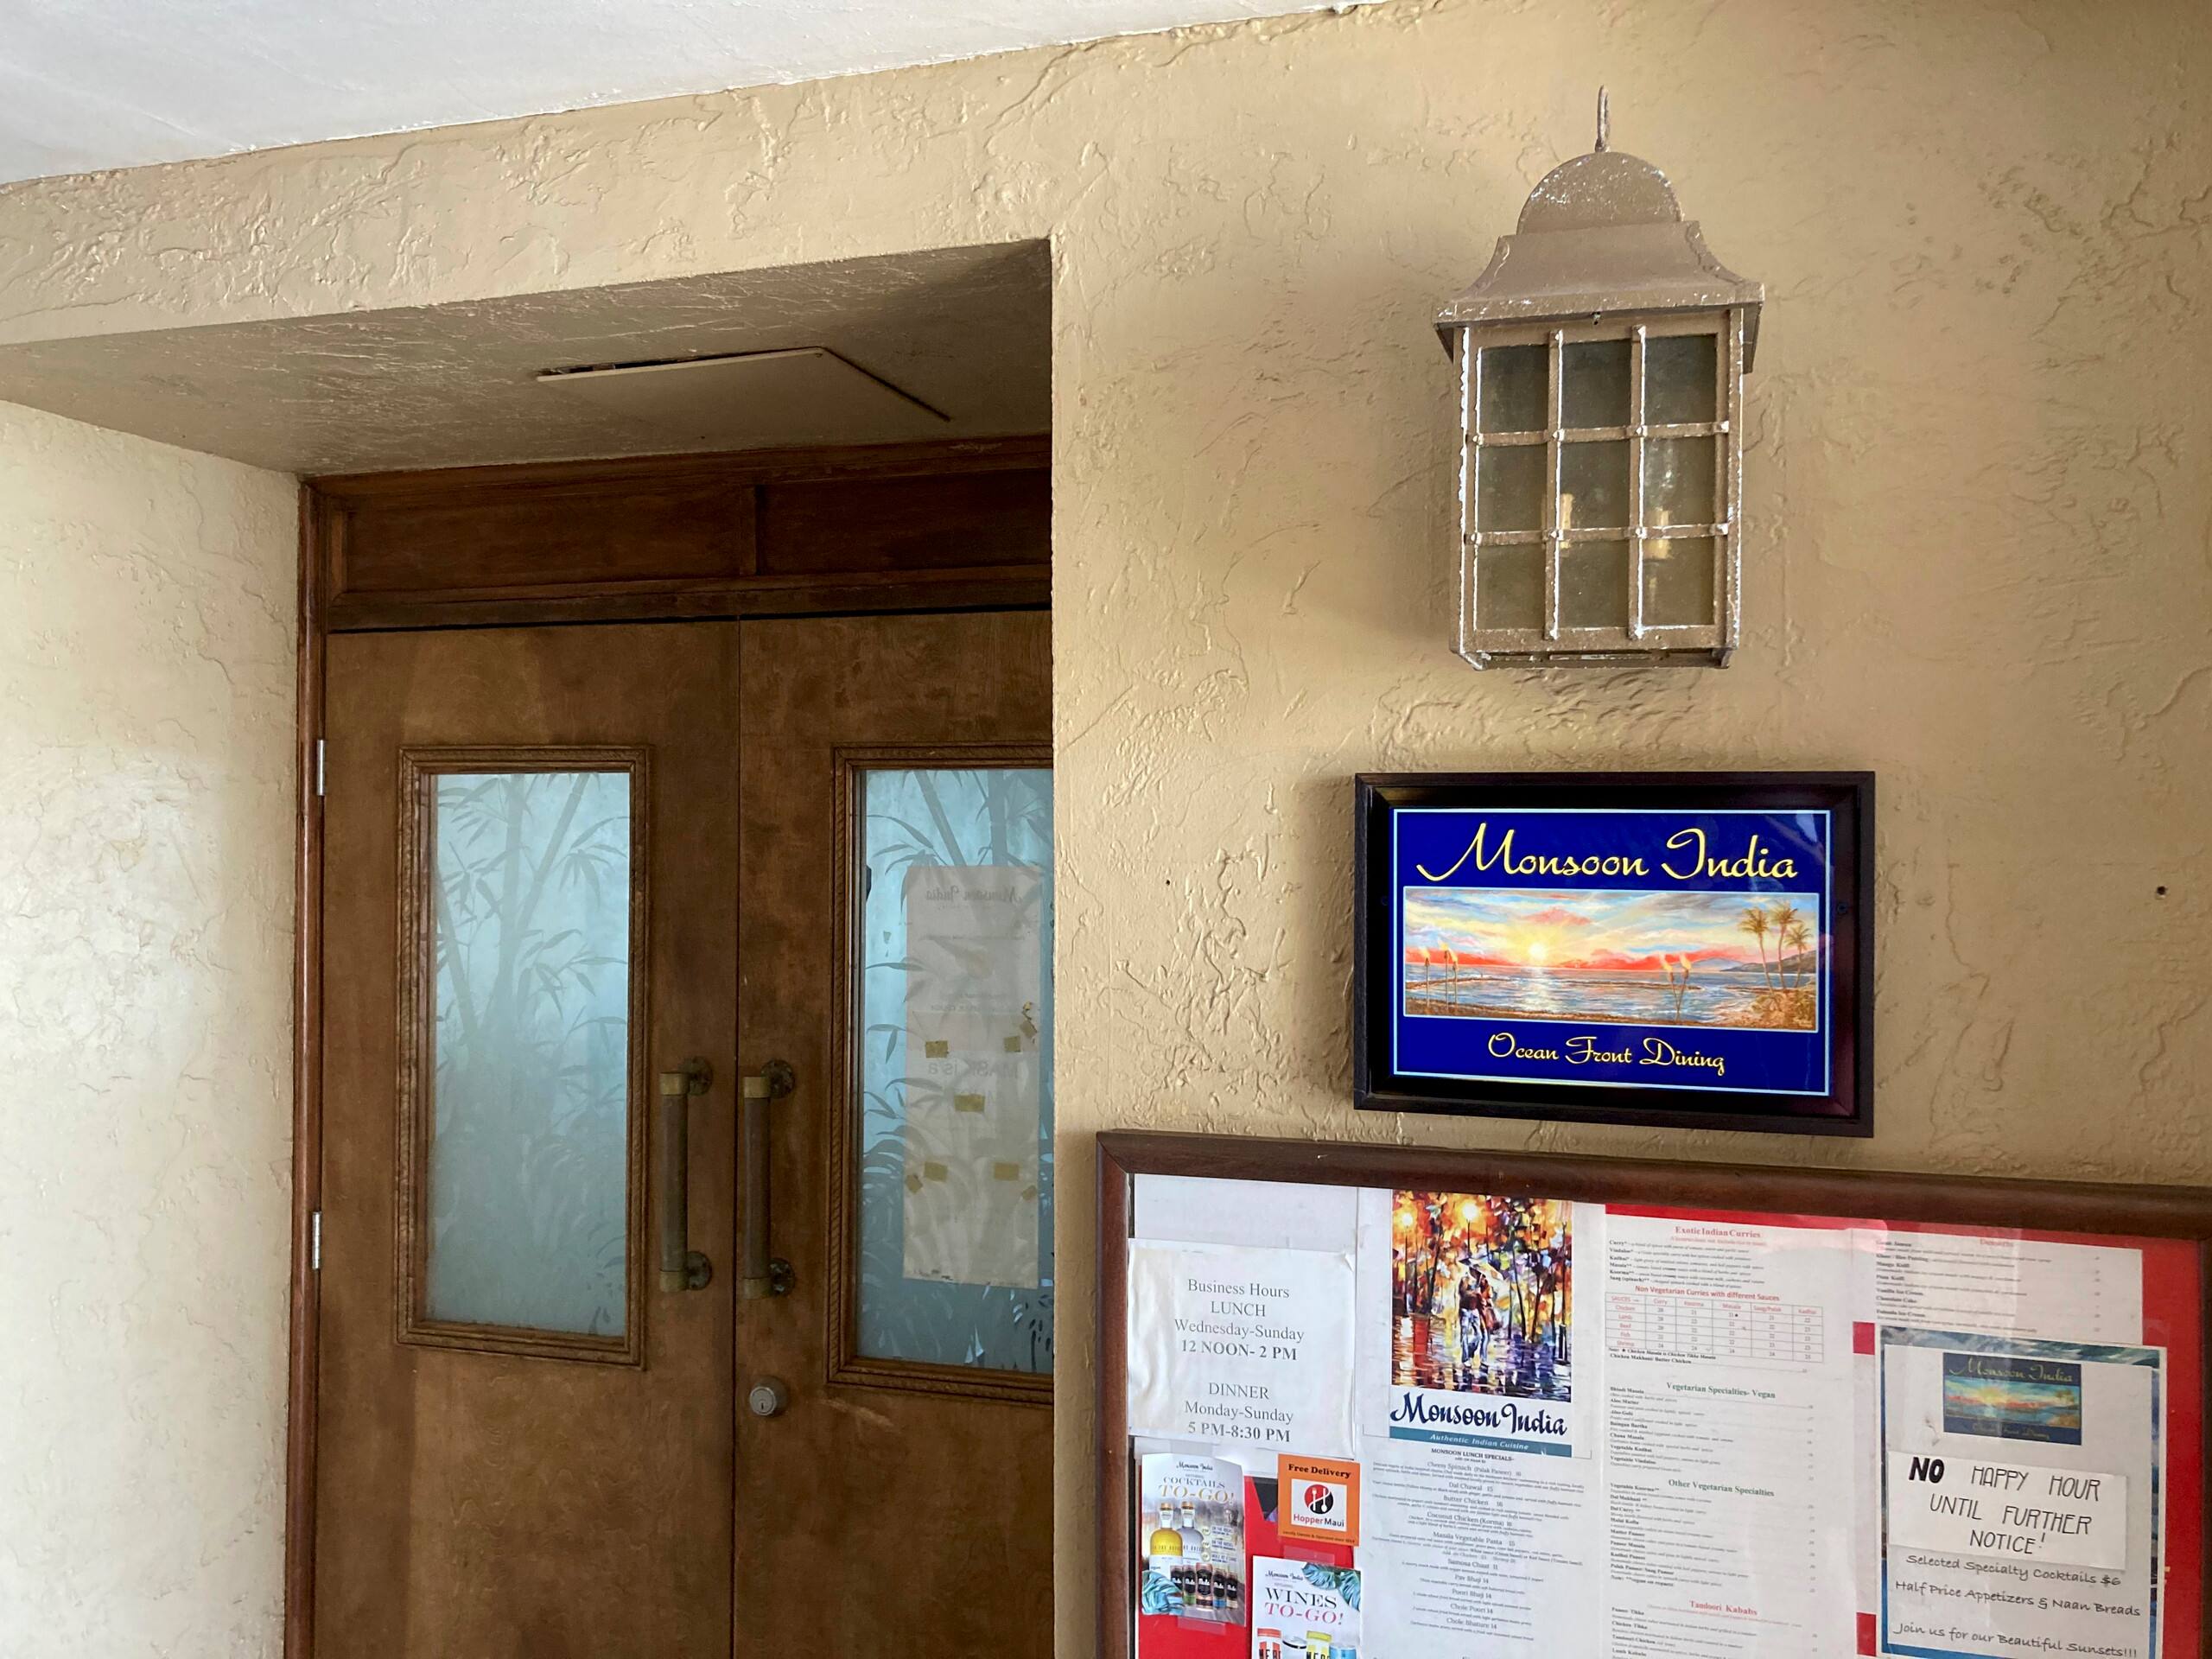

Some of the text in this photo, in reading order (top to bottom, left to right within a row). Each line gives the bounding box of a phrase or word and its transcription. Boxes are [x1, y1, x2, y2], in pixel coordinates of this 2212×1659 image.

[1417, 823, 1797, 881] Monsoon India
[1488, 1033, 1726, 1076] Ocean Front Dining
[1675, 1226, 1761, 1238] Exotic Indian Curries
[1188, 1279, 1290, 1298] Business Hours
[1649, 1286, 1685, 1295] Vegetarian
[1686, 1288, 1709, 1297] Curries
[1726, 1292, 1756, 1300] different
[1211, 1301, 1266, 1317] LUNCH
[1174, 1319, 1305, 1344] Wednesday-Sunday
[1181, 1339, 1298, 1361] 12 NOON- 2 PM
[1209, 1382, 1269, 1400] DINNER
[1667, 1382, 1707, 1394] Vegetarian
[1751, 1389, 1776, 1400] Vegan
[1185, 1401, 1294, 1425] Monday-Sunday
[1389, 1390, 1501, 1427] Monsoon
[1500, 1402, 1568, 1436] India
[1188, 1421, 1292, 1443] 5 PM-8:30 PM
[1430, 1433, 1529, 1452] Authentic Indian Cuisine
[1288, 1463, 1352, 1479] Free Delivery
[1909, 1457, 2101, 1502] NO HAPPY HOUR
[1163, 1476, 1225, 1489] COCKTAILS
[1669, 1478, 1775, 1497] Other Vegetarian Specialties
[1158, 1484, 1236, 1505] TO-GO!
[1929, 1494, 2092, 1535] UNTIL FURTHER
[1905, 1554, 2122, 1586] Selected Specialty Cocktails $6
[1265, 1587, 1338, 1610] WINES
[1689, 1599, 1721, 1611] Tandoori
[1726, 1605, 1758, 1617] Kababs
[1896, 1580, 2141, 1618] Half Price Appetizers & Naan Breads
[1264, 1602, 1344, 1626] TO-GO!
[1893, 1623, 2138, 1658] Join us for our Beautiful Sunsets!!!
